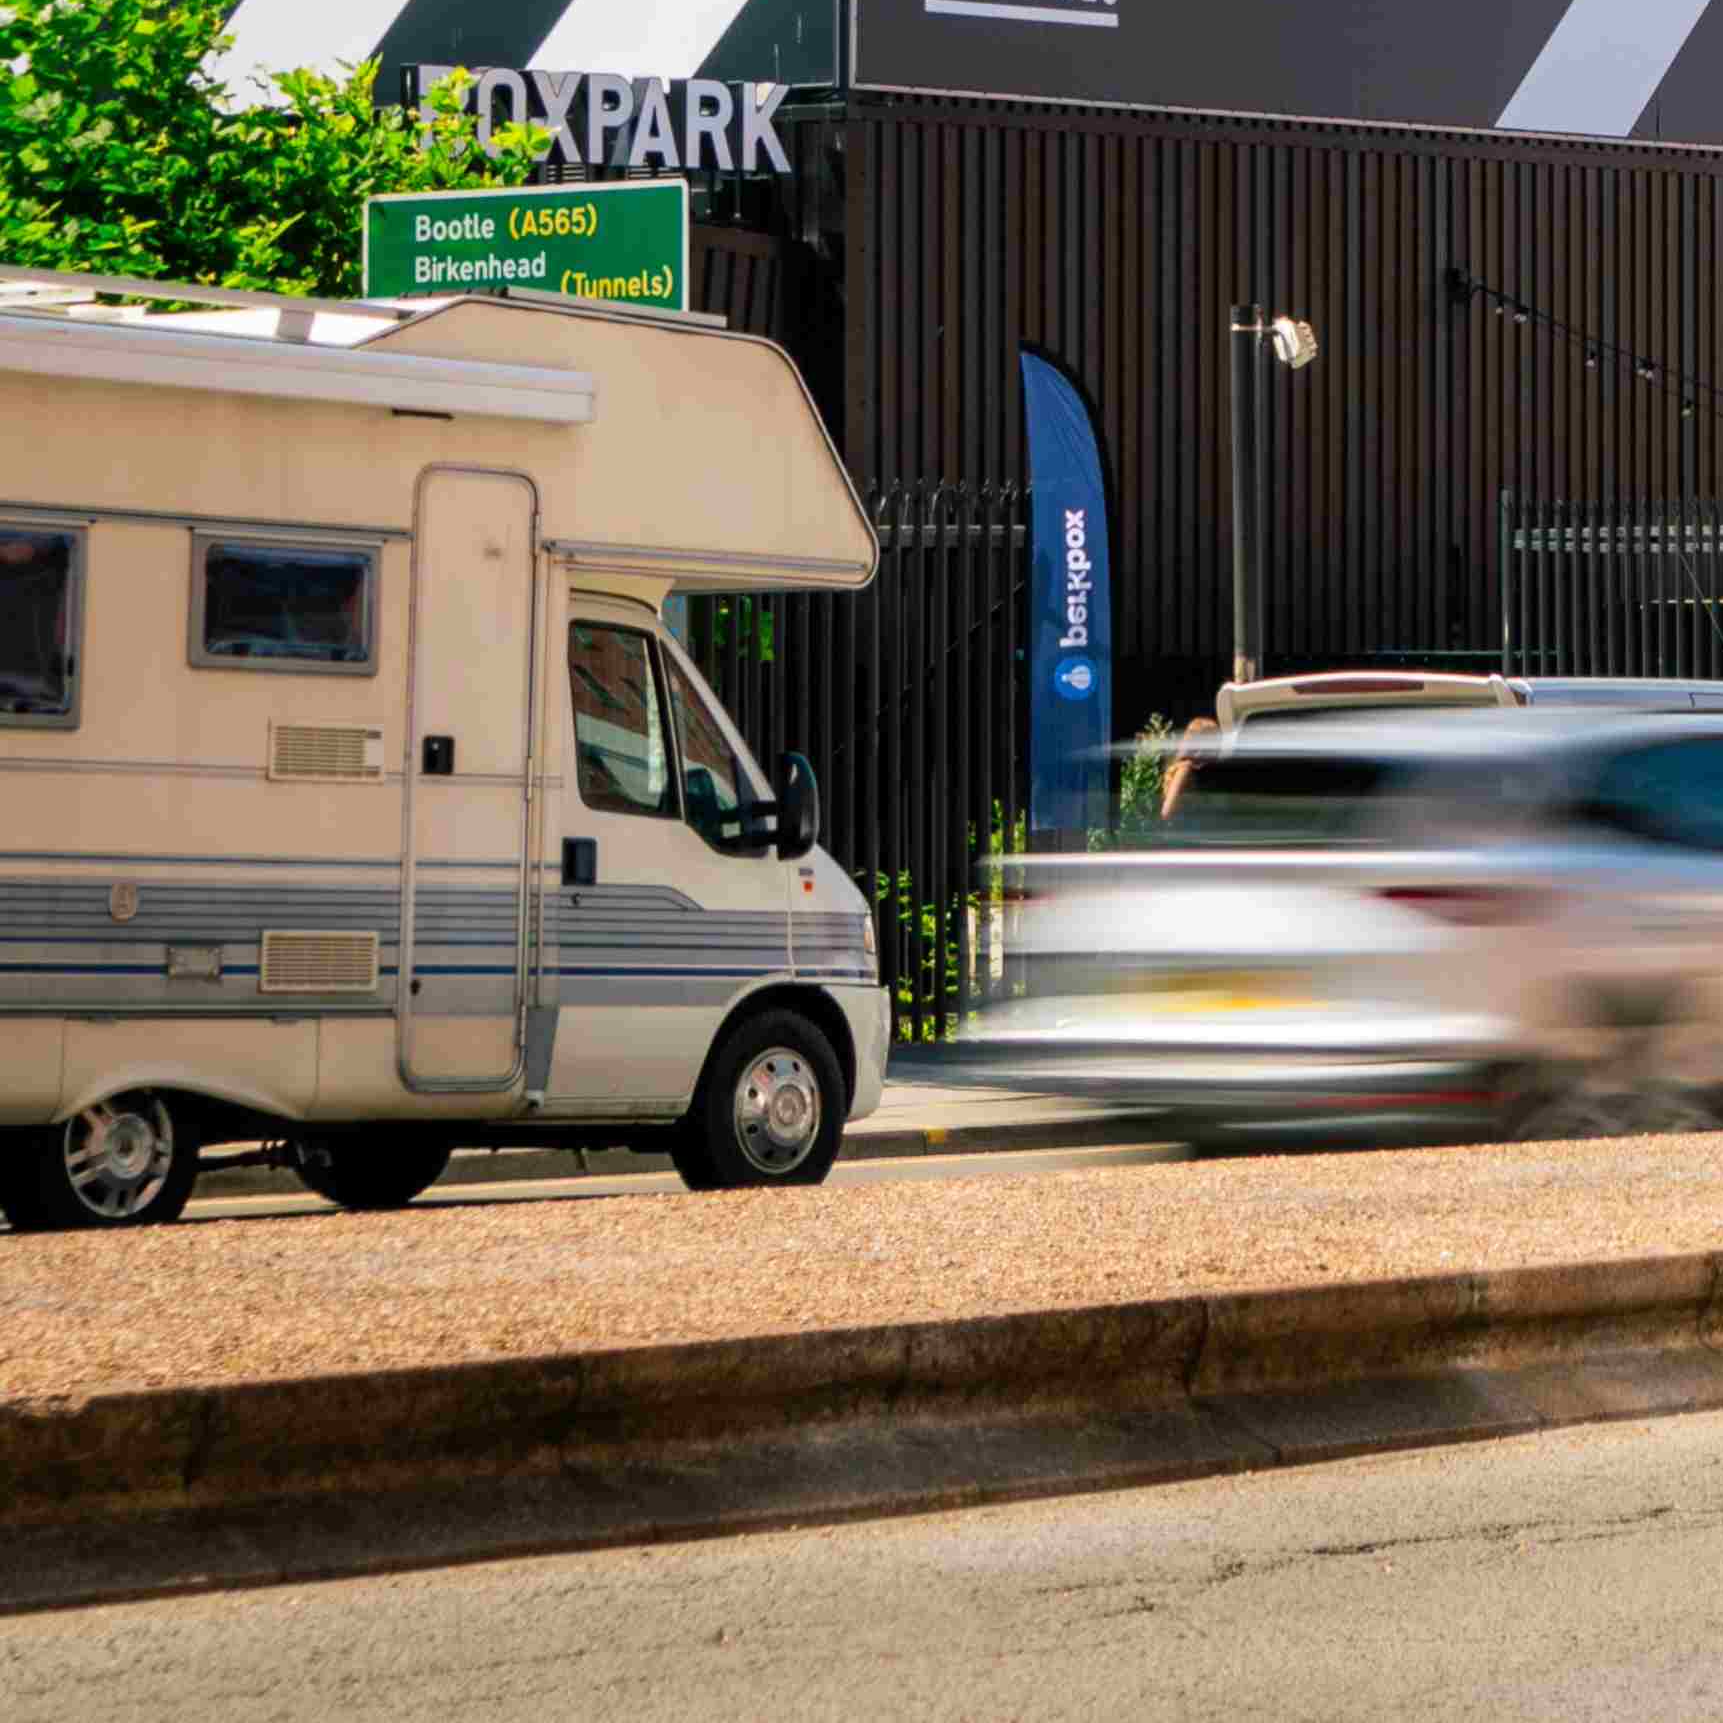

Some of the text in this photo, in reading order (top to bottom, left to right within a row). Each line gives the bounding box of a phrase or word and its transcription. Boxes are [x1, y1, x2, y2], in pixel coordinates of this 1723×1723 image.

[414, 202, 598, 242] Bootle (A565)
[414, 250, 546, 284] Birkenhead
[560, 264, 674, 300] (Tunnels)
